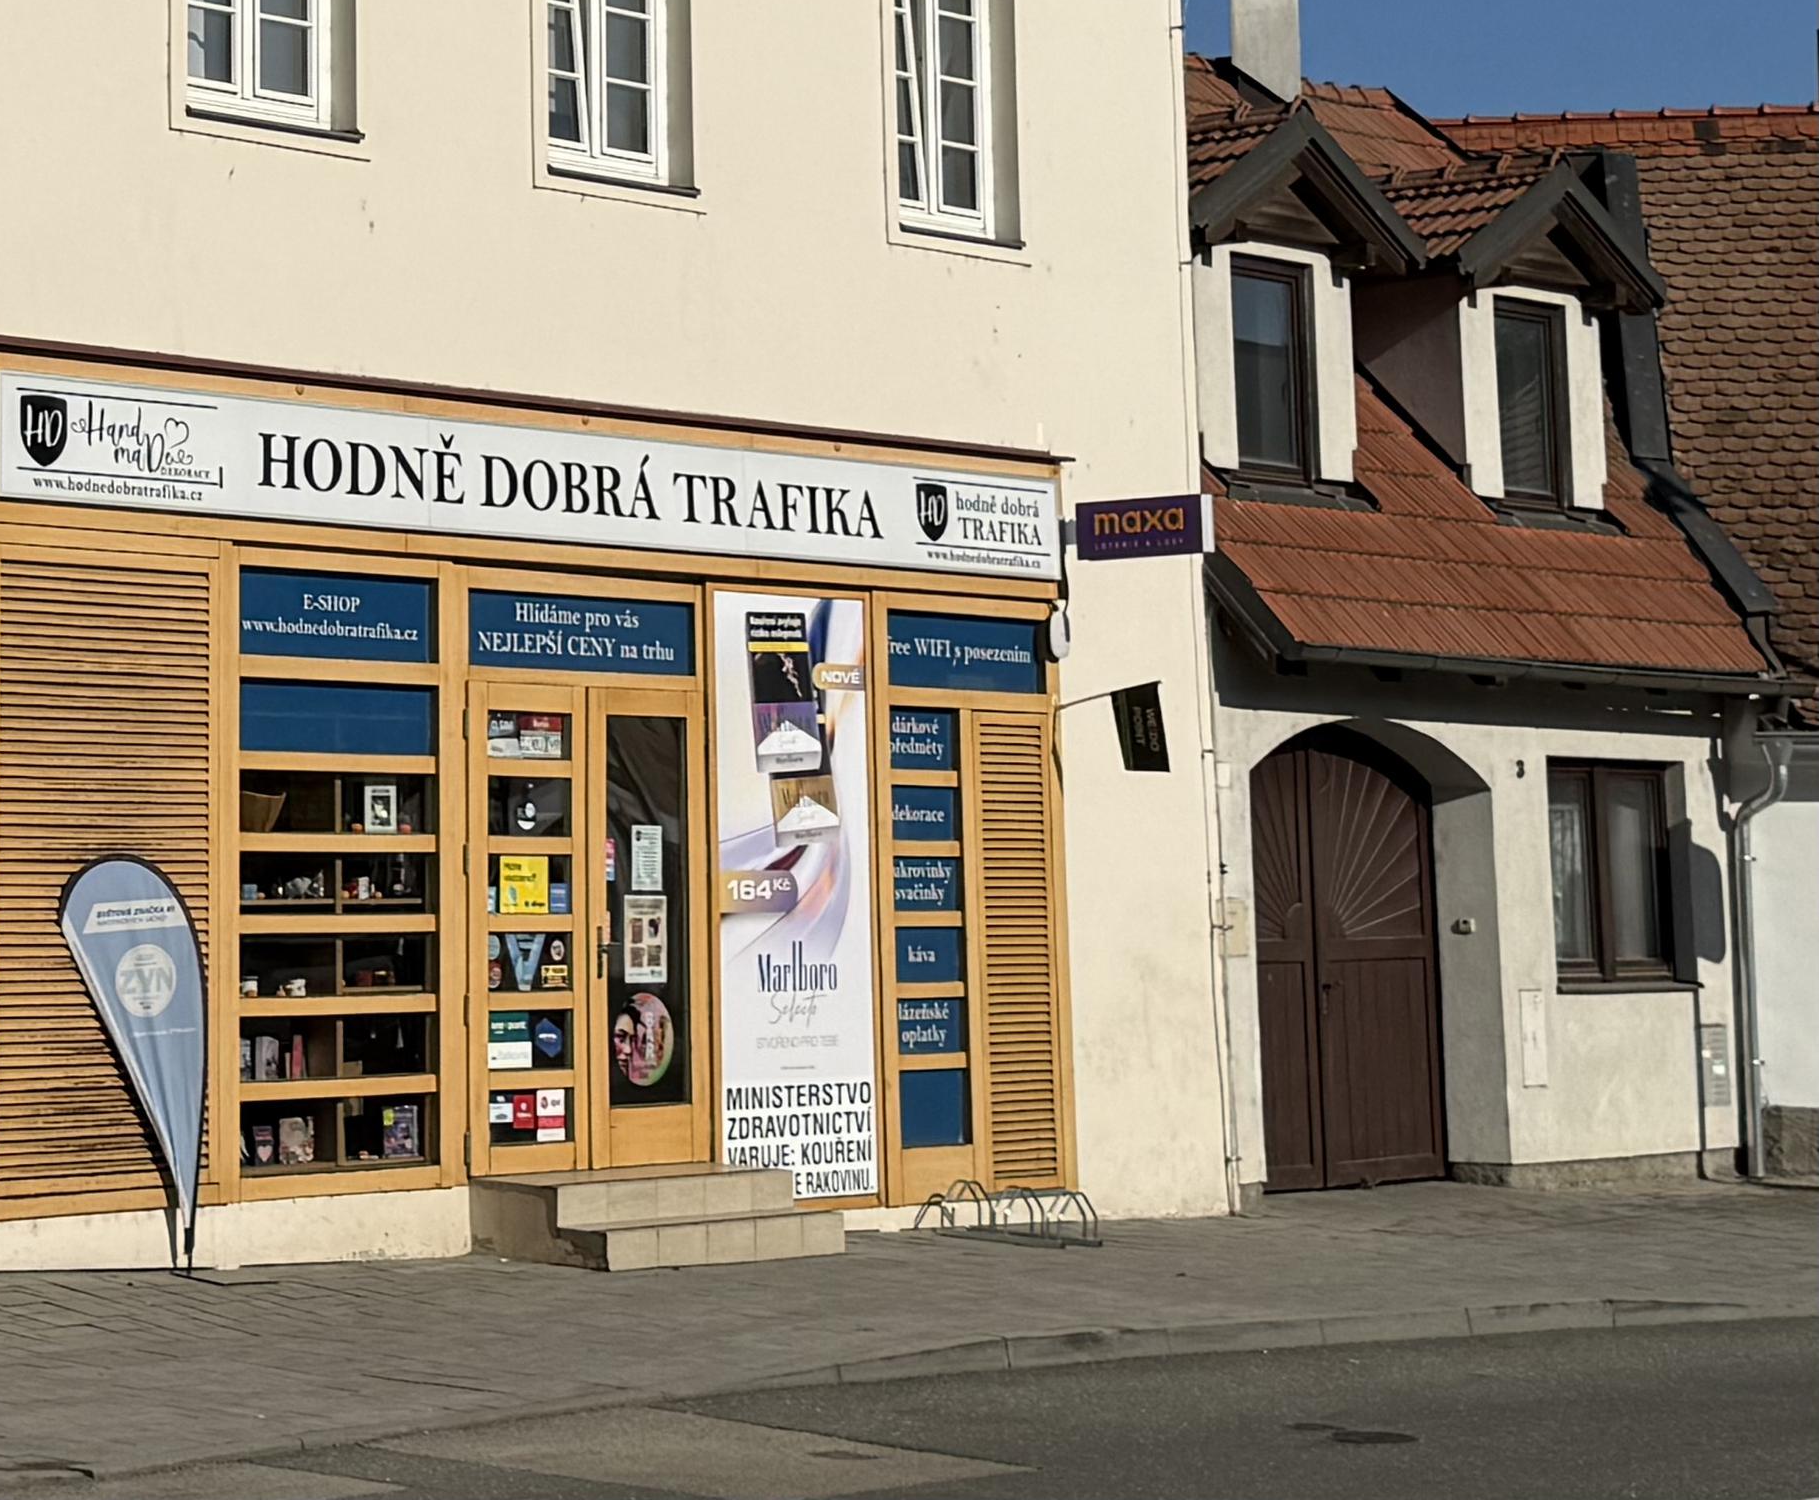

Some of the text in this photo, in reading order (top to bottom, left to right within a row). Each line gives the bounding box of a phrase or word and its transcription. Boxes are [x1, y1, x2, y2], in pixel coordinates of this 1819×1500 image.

[33, 476, 203, 501] www.hodnedobratrafika.cz
[257, 432, 884, 540] HODNĚ DOBRÁ TRAFIKA
[955, 490, 1040, 519] hodně dobrá
[957, 516, 1043, 546] TRAFIKA
[1093, 508, 1184, 536] maxa
[303, 593, 361, 613] E-SHOP
[515, 602, 640, 632] Hlídáme pro vás
[241, 616, 419, 641] www.hodnedobratrafika.cz
[478, 630, 675, 661] NEJLEPŠÍ CENY na trhu
[820, 668, 861, 685] NOVÉ
[892, 716, 940, 735] dárkové
[727, 877, 791, 900] 164 Kč
[895, 882, 945, 906] svačinky
[758, 941, 838, 993] Marlboro
[907, 945, 936, 963] káva
[120, 966, 173, 995] ZYN
[898, 1002, 950, 1021] lázeňské
[901, 1025, 947, 1048] oplatky
[726, 1081, 872, 1111] MINISTERSTVO
[727, 1106, 872, 1141] ZDRAVOTNICTVÍ
[727, 1135, 873, 1169] VARUJE: KOUŘENÍ
[806, 1167, 875, 1195] RAKOVINU.
